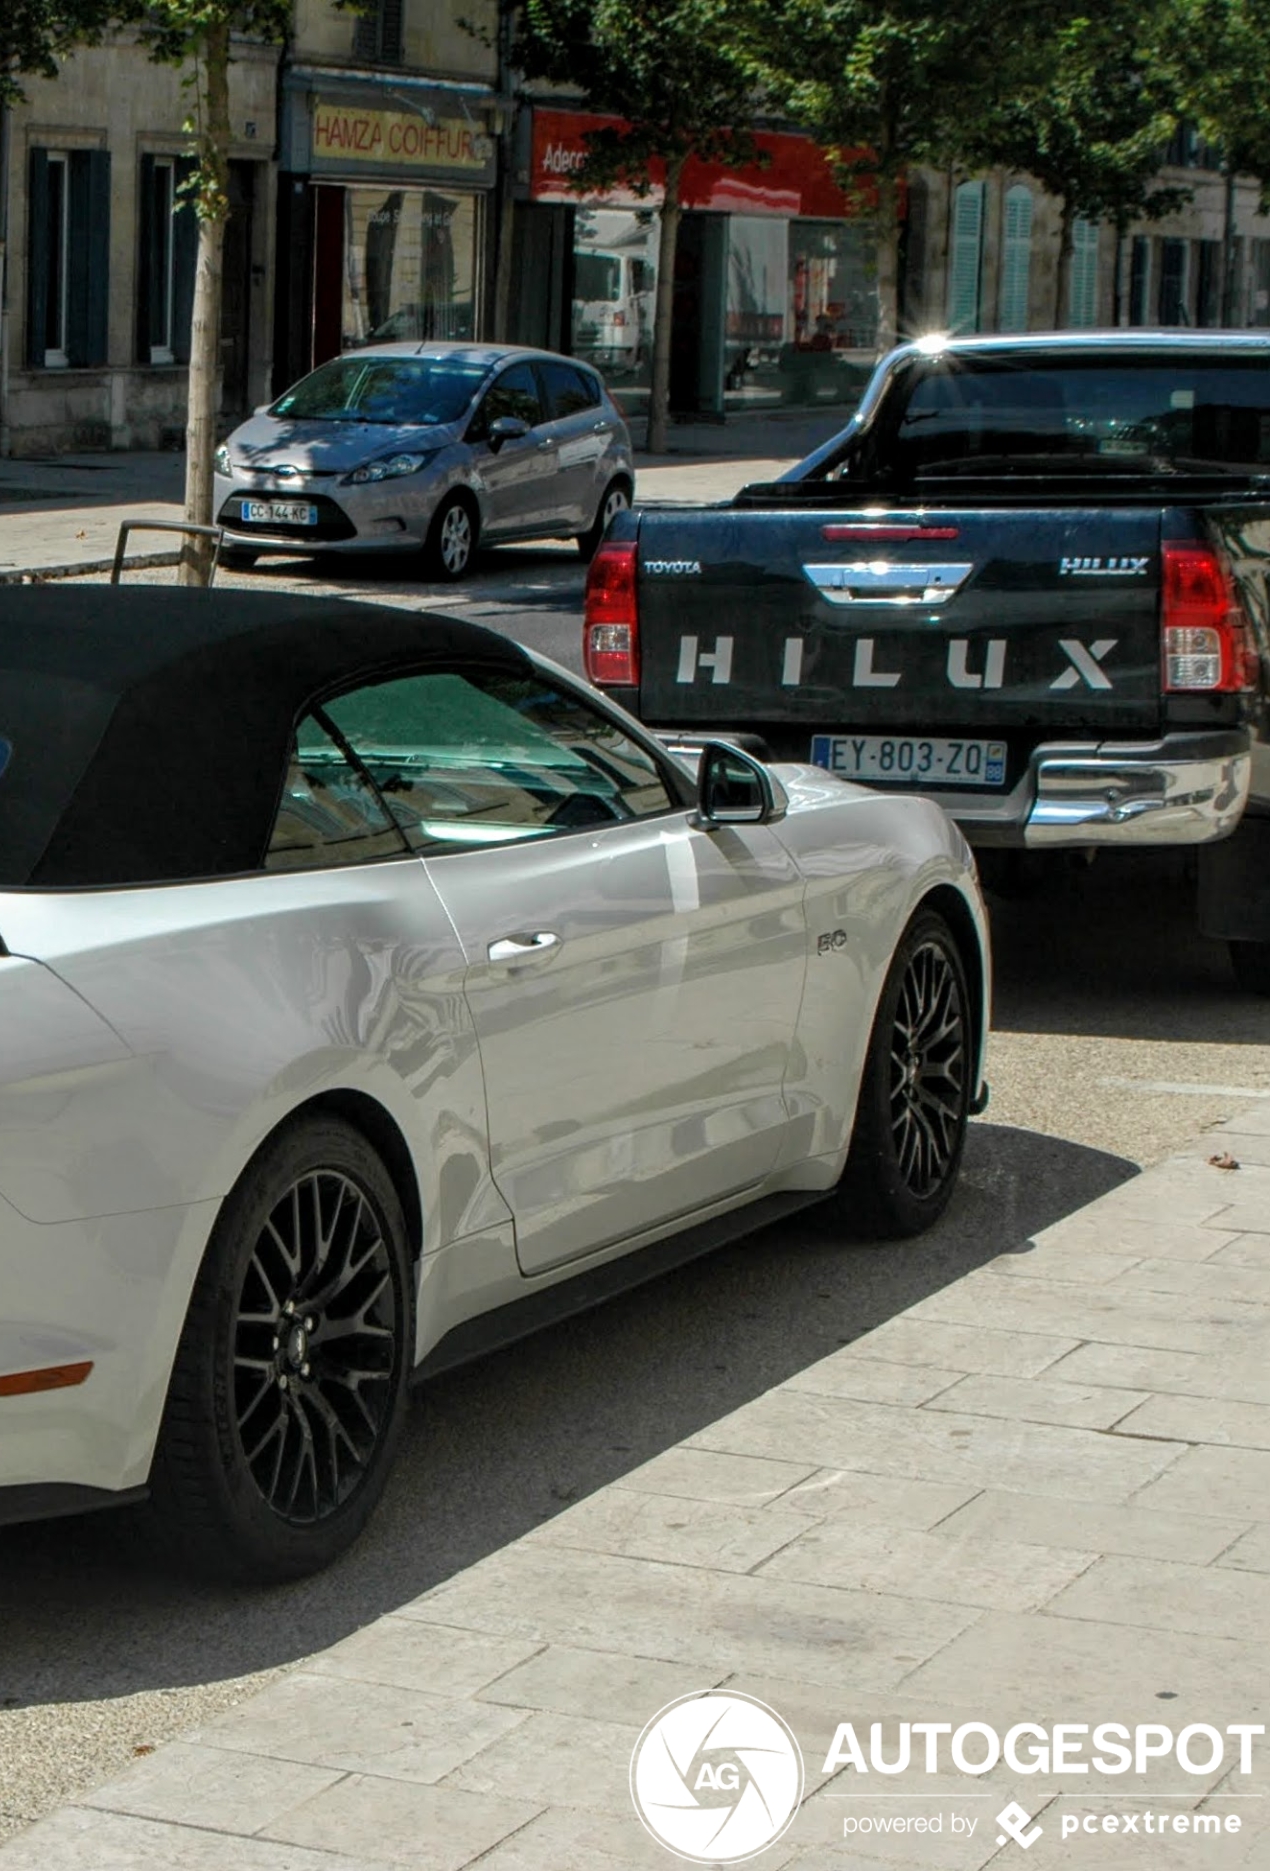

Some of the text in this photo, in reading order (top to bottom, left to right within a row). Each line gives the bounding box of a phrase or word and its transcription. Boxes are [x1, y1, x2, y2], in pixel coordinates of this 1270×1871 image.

[315, 114, 488, 161] HAMZA COIFFUR
[542, 141, 590, 173] Adecc
[644, 560, 702, 574] TOYOTA
[1059, 557, 1149, 575] HILUX
[676, 635, 1119, 690] HILUX
[831, 739, 981, 776] EY-803-ZQ
